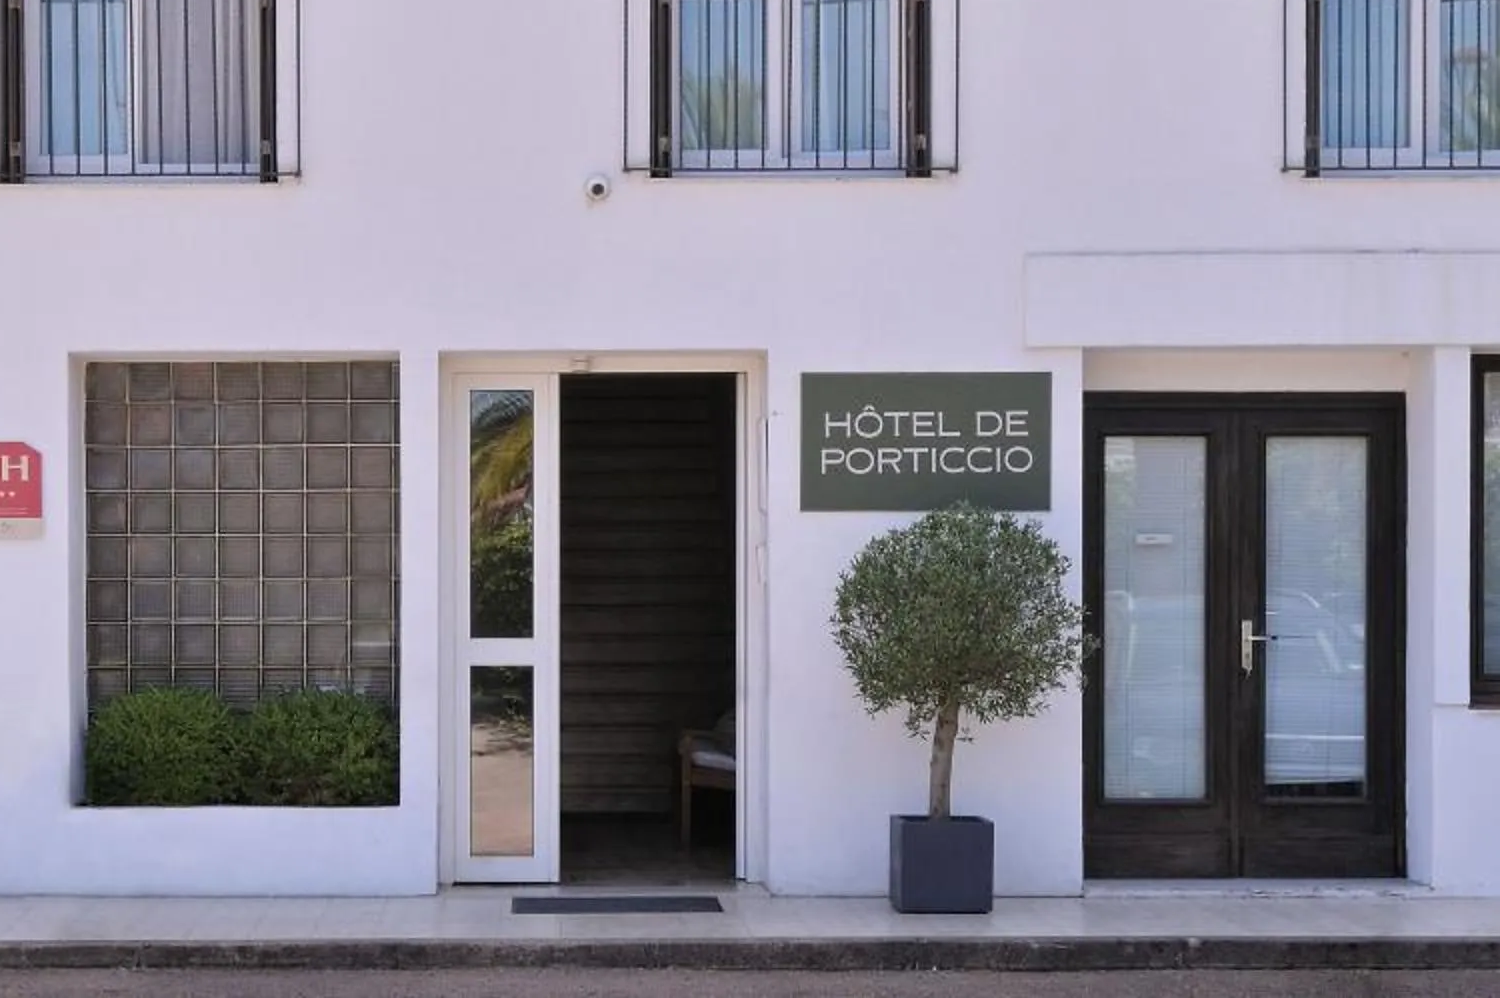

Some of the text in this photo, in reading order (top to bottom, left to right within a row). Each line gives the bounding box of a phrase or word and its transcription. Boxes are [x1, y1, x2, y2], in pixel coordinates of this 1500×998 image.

[825, 405, 1029, 439] HÔTEL DE
[0, 454, 30, 482] H
[820, 446, 1034, 475] PORTICCIO
